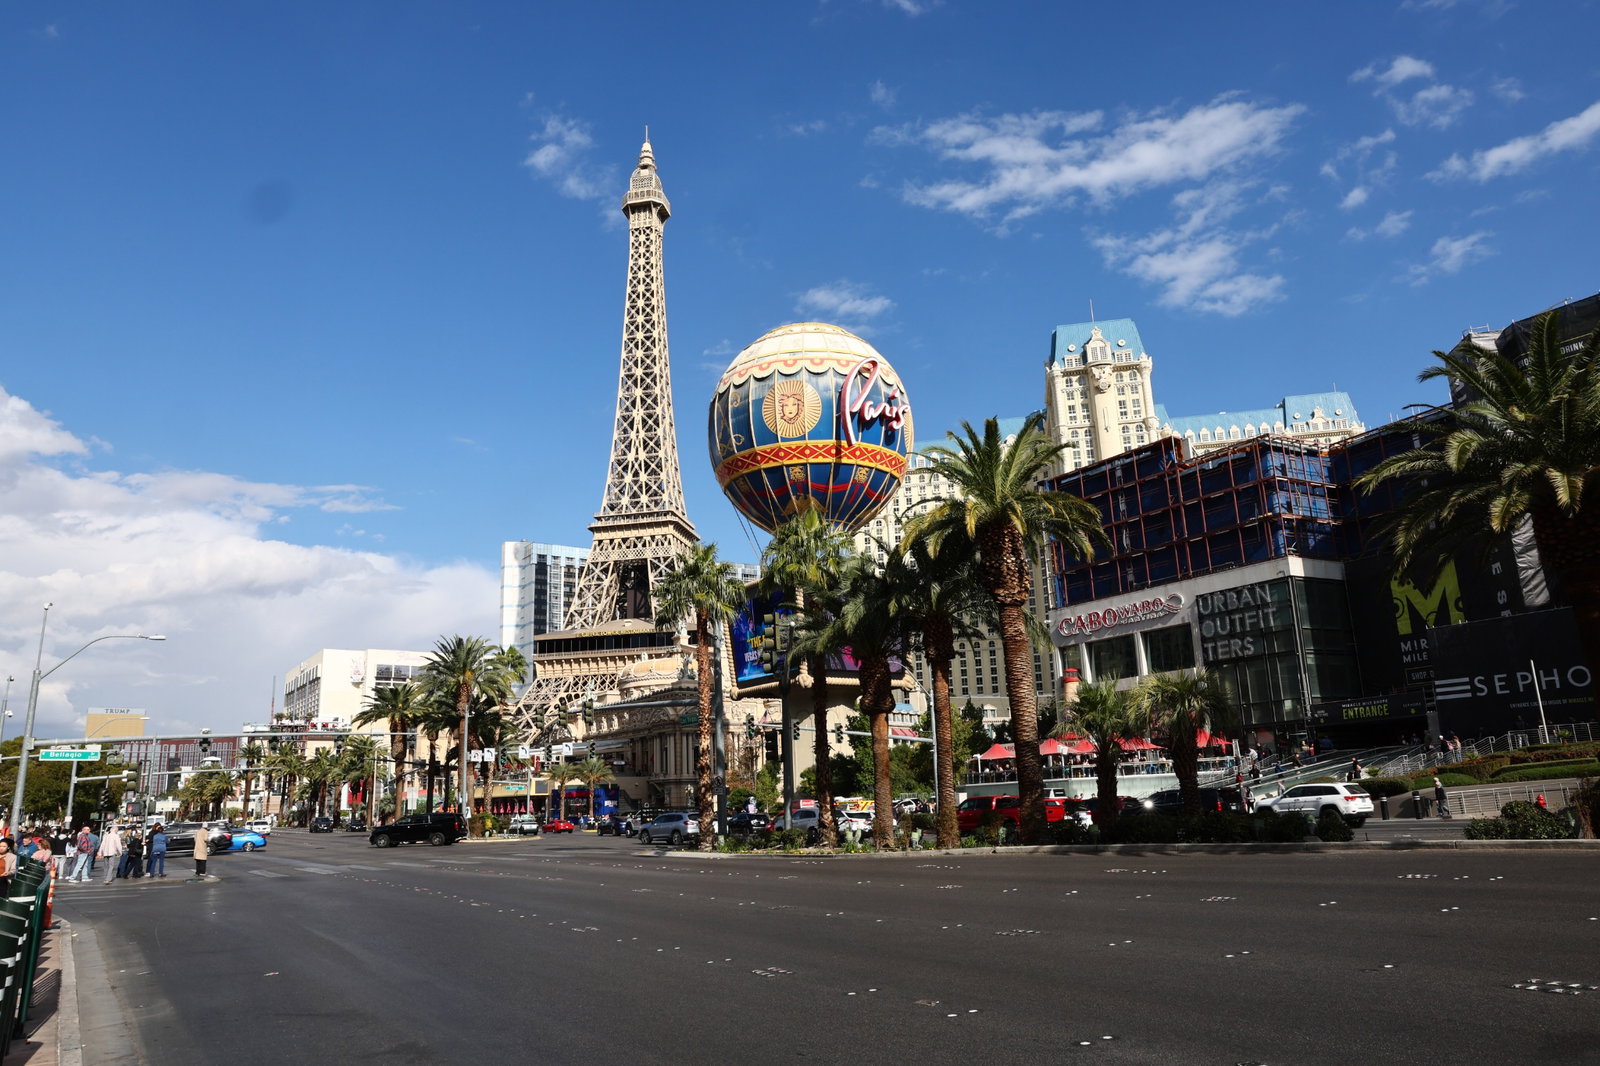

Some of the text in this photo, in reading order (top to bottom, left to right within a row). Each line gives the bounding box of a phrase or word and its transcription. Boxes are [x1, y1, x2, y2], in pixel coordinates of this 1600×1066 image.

[1560, 341, 1585, 355] DRINK
[840, 356, 911, 446] Paris
[1199, 584, 1272, 615] URBAN
[1058, 597, 1165, 637] CABO WABO
[1202, 607, 1276, 638] OUTFIT
[1203, 636, 1255, 661] TERS
[1400, 638, 1429, 653] MIR
[1402, 651, 1429, 664] MILE
[1474, 665, 1592, 697] SEPHO
[1342, 703, 1389, 720] ENTRANCE
[49, 751, 82, 759] Bellagio
